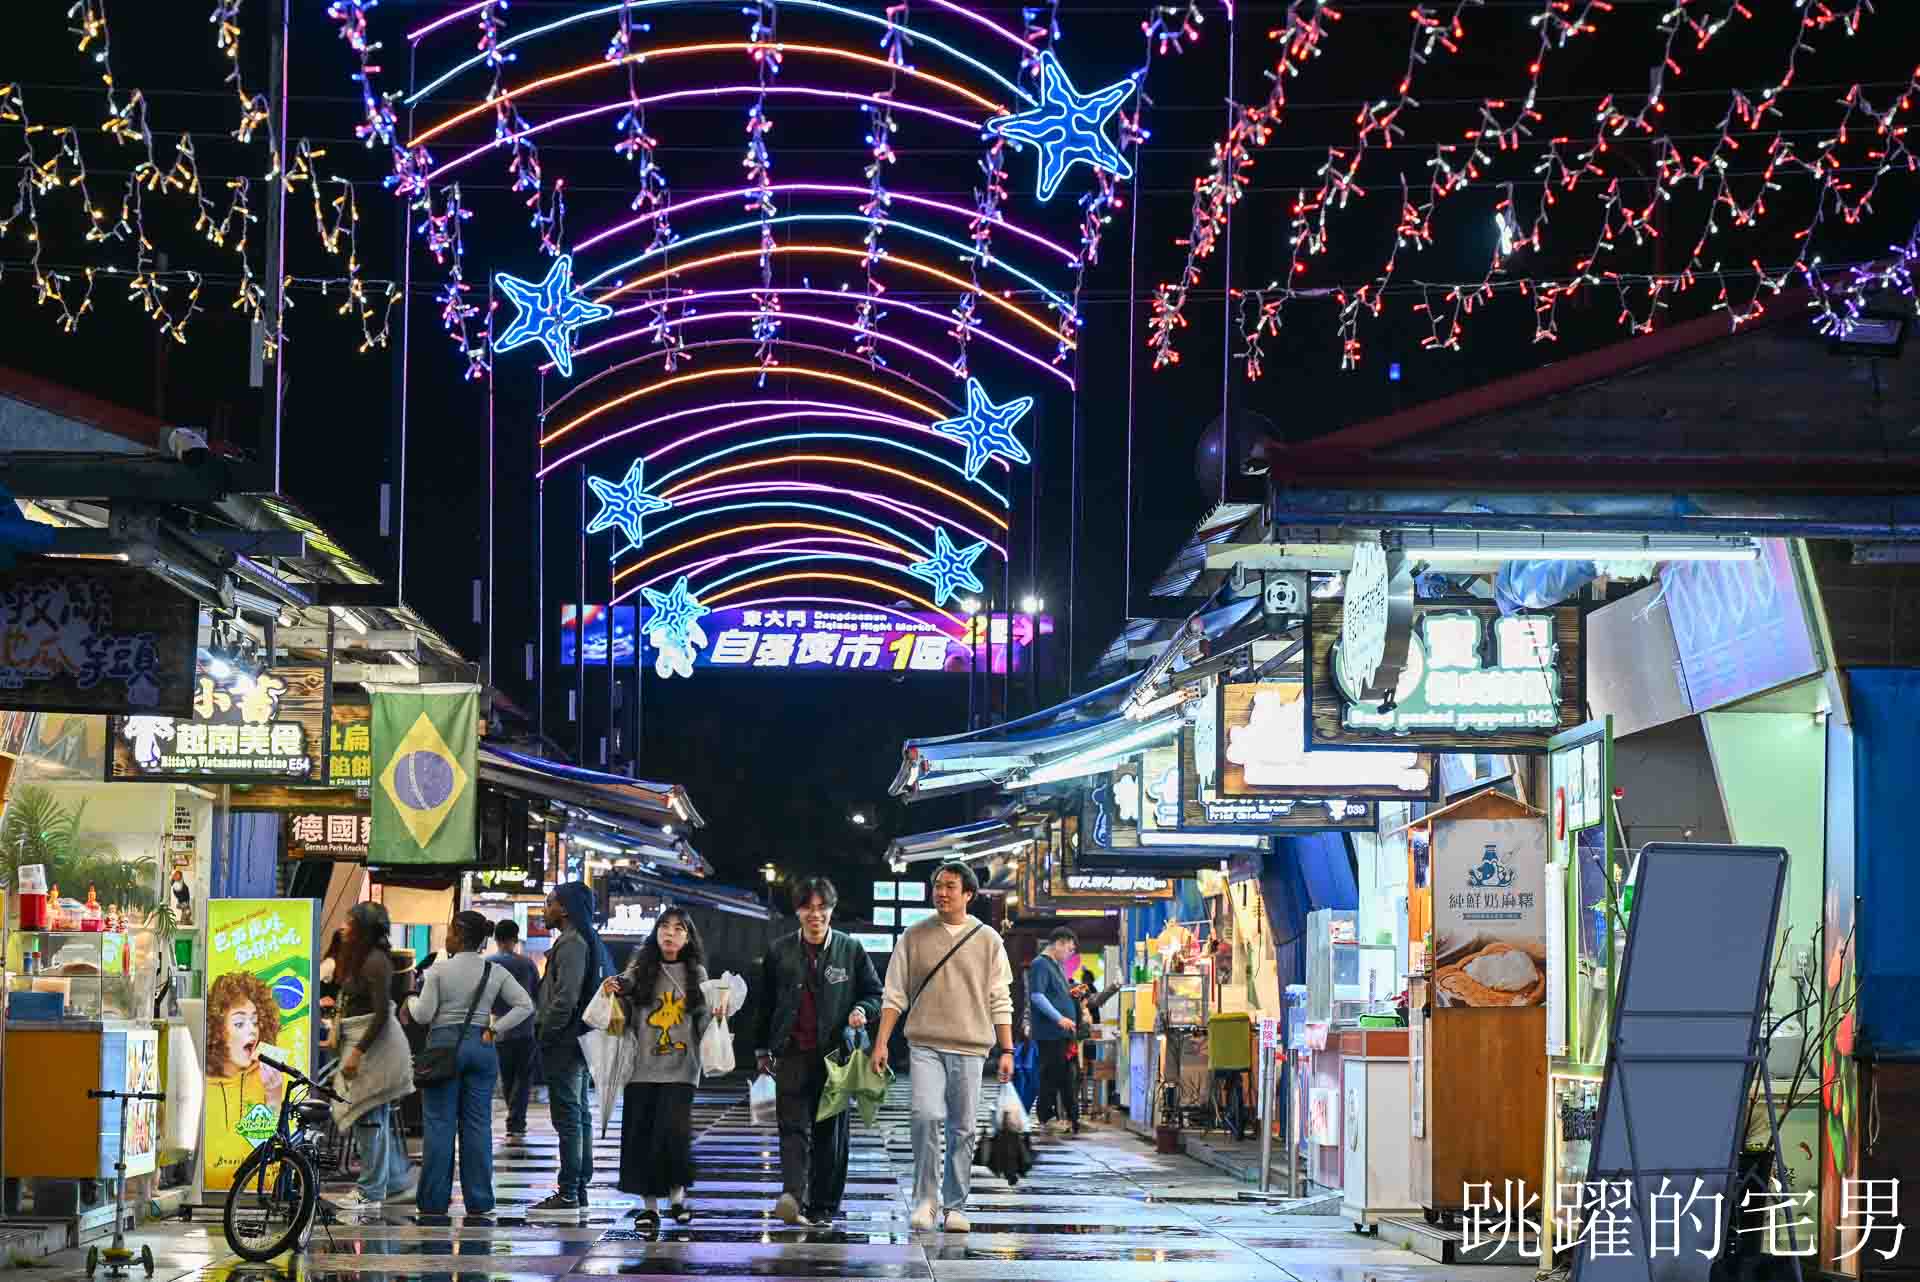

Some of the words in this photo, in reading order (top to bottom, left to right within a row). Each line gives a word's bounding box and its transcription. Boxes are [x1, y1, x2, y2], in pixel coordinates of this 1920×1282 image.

[743, 610, 807, 628] 東大門
[860, 622, 892, 632] Night
[176, 723, 302, 755] 越南美食
